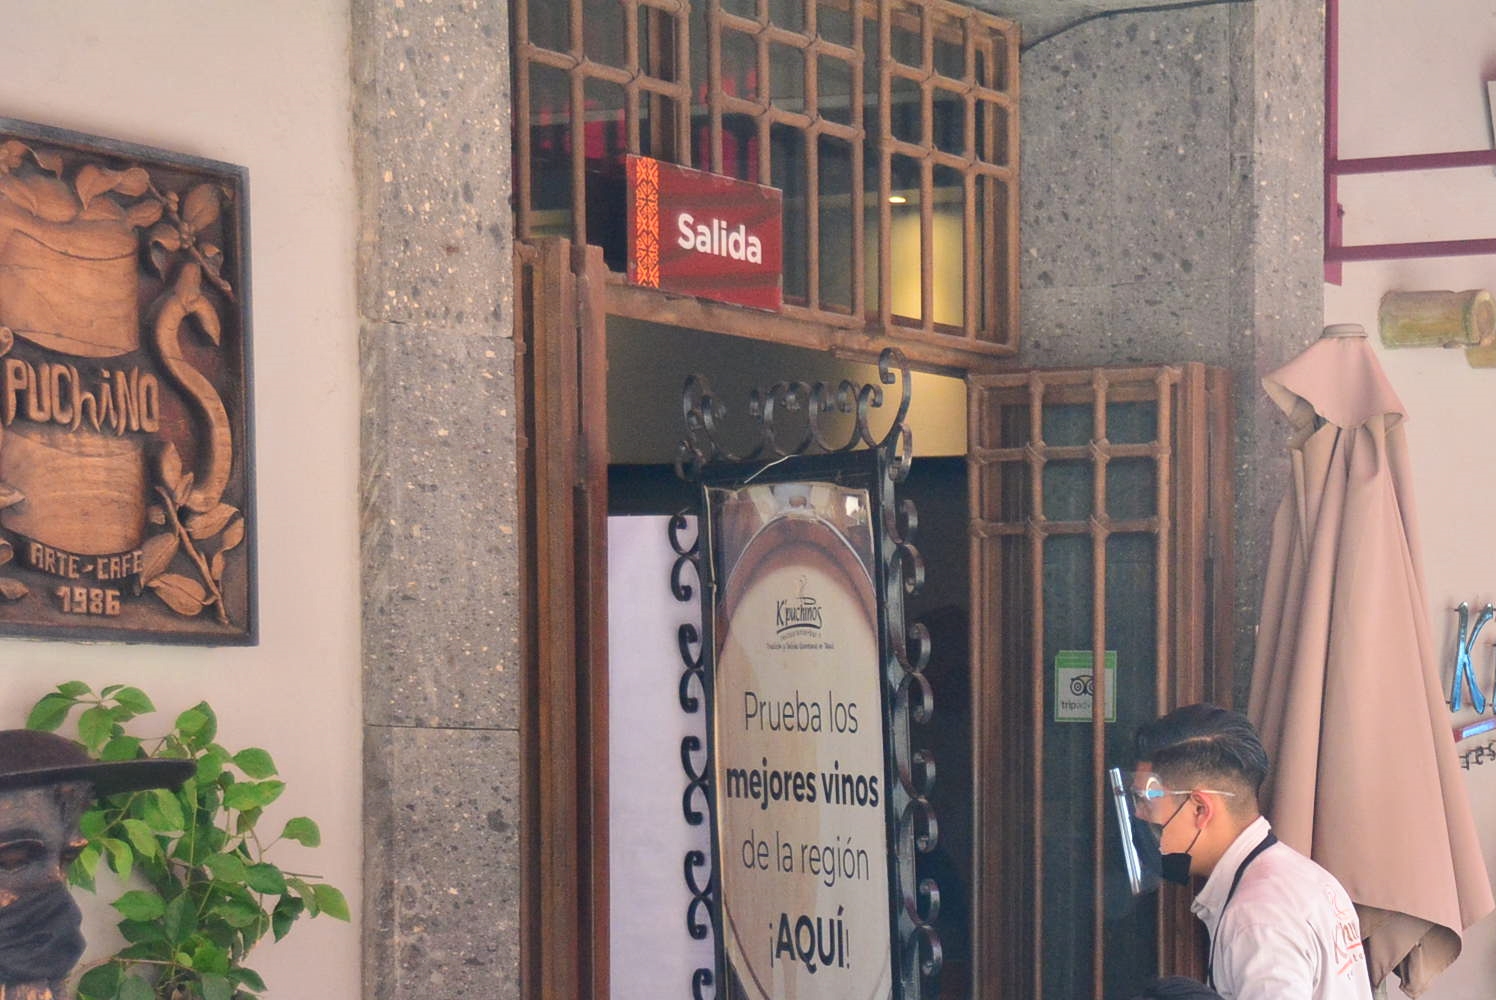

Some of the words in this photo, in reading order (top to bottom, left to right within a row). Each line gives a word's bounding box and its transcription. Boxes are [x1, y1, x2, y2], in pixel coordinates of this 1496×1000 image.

[677, 212, 763, 265] Salida
[57, 586, 121, 615] 1986
[744, 690, 822, 733] Prueba
[828, 690, 859, 734] los
[725, 757, 817, 810] mejores
[821, 760, 879, 808] vinos
[741, 829, 769, 871] de
[776, 830, 794, 873] la
[800, 837, 870, 887] región
[768, 905, 850, 974] ¡AQUÍ!
